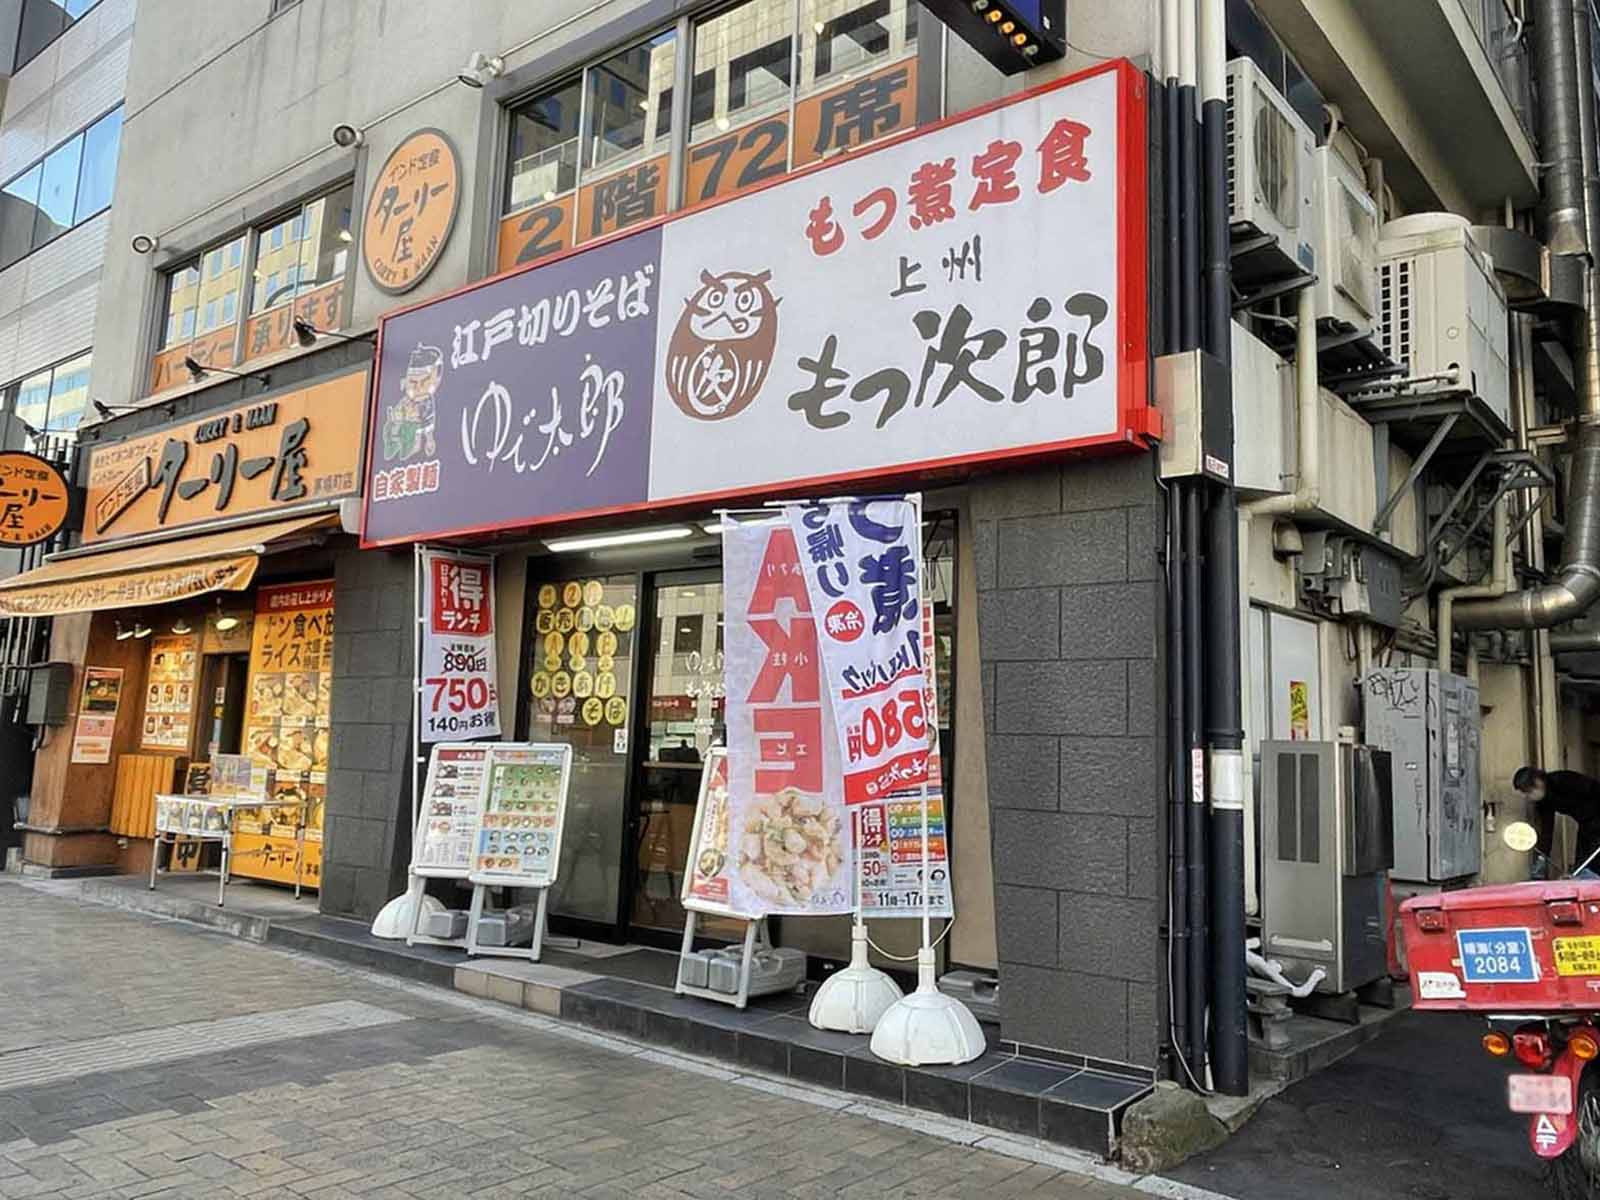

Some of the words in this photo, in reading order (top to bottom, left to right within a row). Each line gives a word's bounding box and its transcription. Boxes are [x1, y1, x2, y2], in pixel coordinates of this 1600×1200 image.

[806, 118, 1092, 256] もつ煮定食
[451, 264, 655, 369] 江戸切りそば
[890, 234, 982, 297] 上州
[787, 292, 1109, 429] もつ次郎
[461, 353, 625, 477] ゆで太郎
[149, 417, 310, 525] ターリー屋
[441, 611, 481, 631] ランチ
[449, 565, 484, 610] 得
[1474, 956, 1521, 974] 2084
